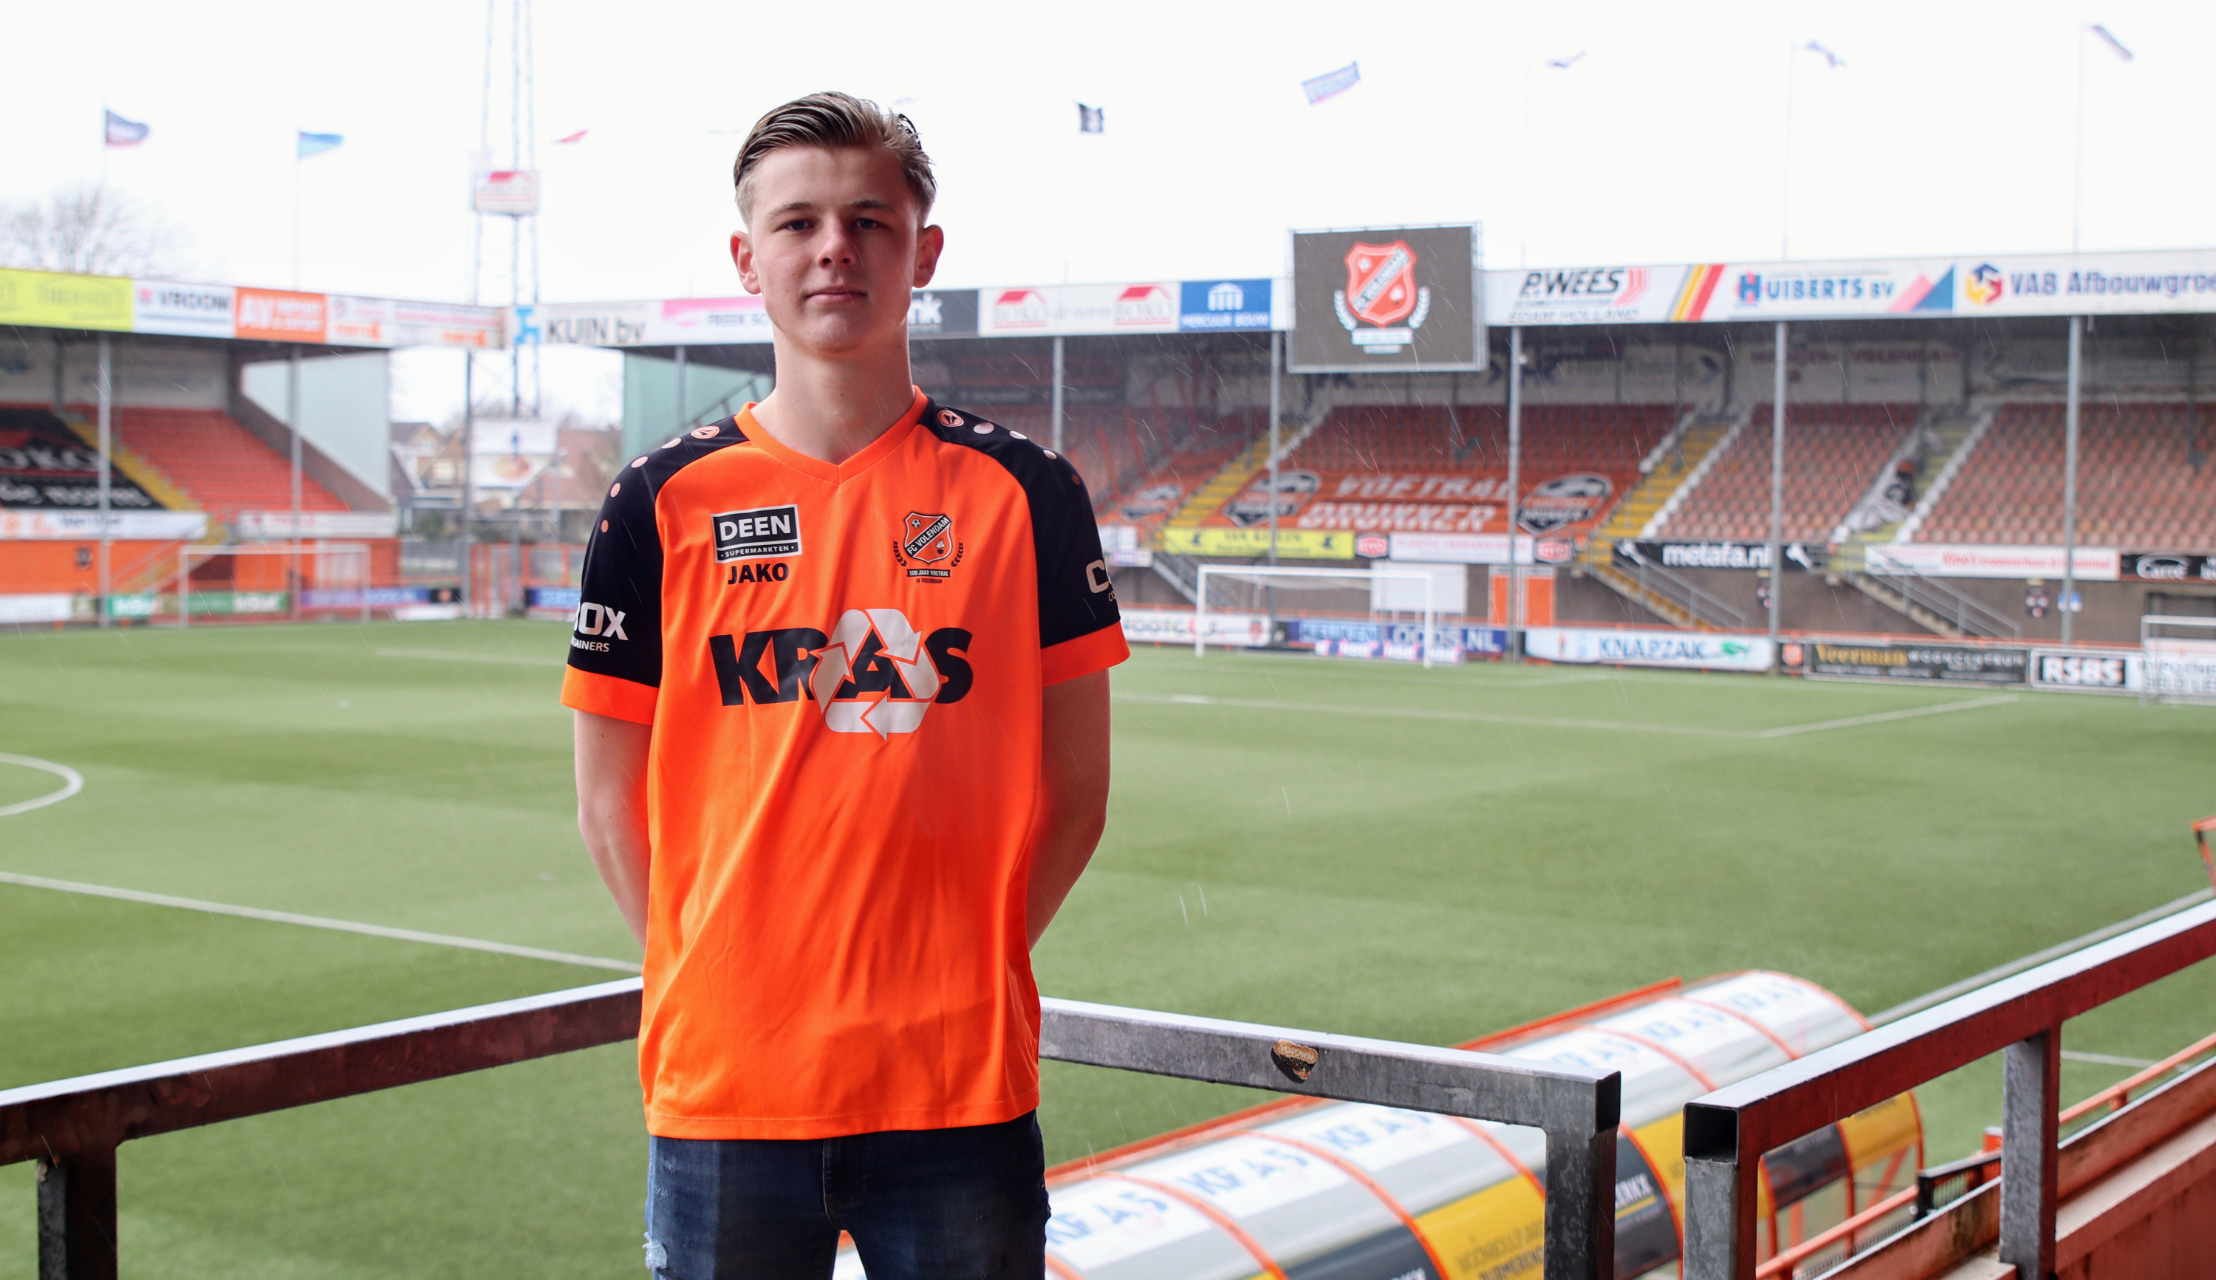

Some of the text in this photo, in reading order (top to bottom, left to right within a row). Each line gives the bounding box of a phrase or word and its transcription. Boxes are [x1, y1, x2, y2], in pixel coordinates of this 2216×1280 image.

[1739, 273, 1863, 299] HUIBERTS
[2011, 272, 2058, 296] VAB
[546, 314, 647, 344] KUIN bv
[719, 514, 791, 541] DEEN
[906, 516, 950, 555] FC VOLENDAM
[725, 545, 789, 557] SUPERMARKTEN
[1662, 542, 1772, 568] metafa.nl
[728, 562, 789, 585] JAKO
[930, 569, 949, 577] VOETBAL
[574, 601, 629, 641] OX
[1600, 637, 1705, 659] KNAPZAK
[709, 627, 973, 706] KRAS
[2042, 657, 2124, 686] RSBS
